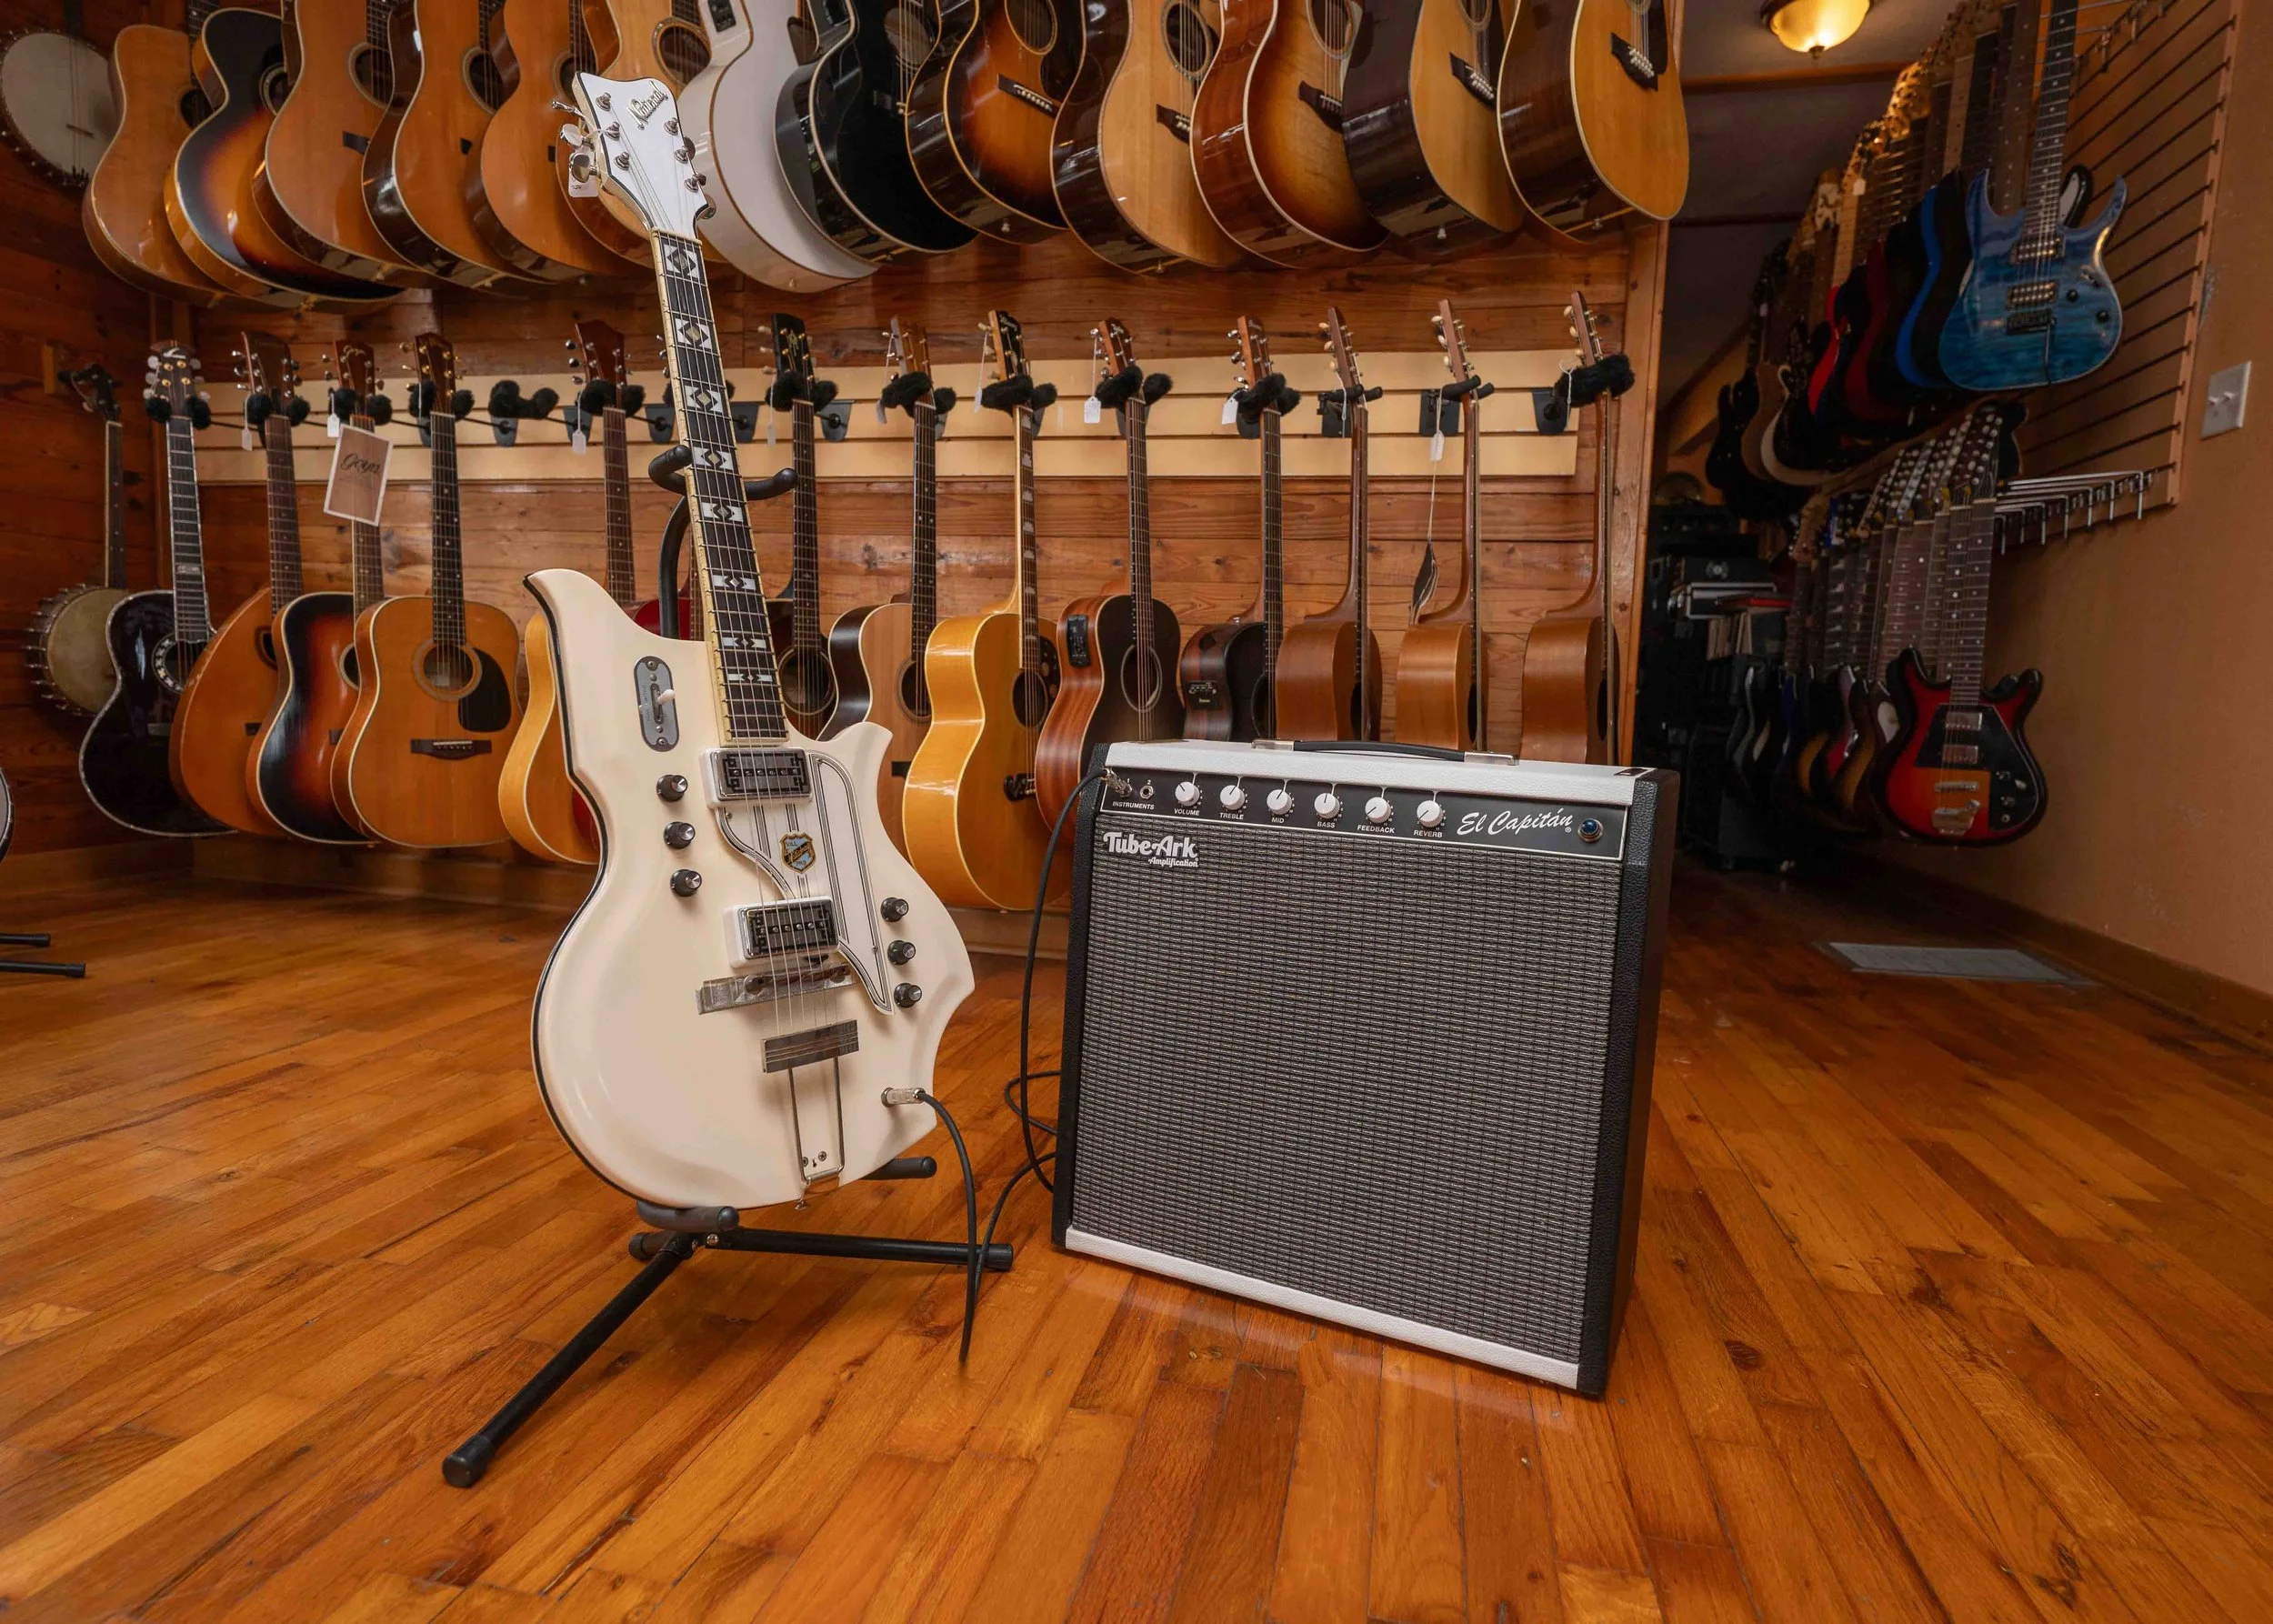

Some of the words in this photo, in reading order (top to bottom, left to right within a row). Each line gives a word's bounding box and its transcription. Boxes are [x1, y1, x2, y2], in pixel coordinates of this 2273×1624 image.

[1112, 801, 1155, 809] INSTRUMENTS
[1457, 812, 1487, 835] El
[1487, 807, 1573, 835] Capitán
[1357, 825, 1395, 834] FEEDBACK
[1413, 829, 1443, 838] REVERB
[1148, 857, 1198, 867] Amplification
